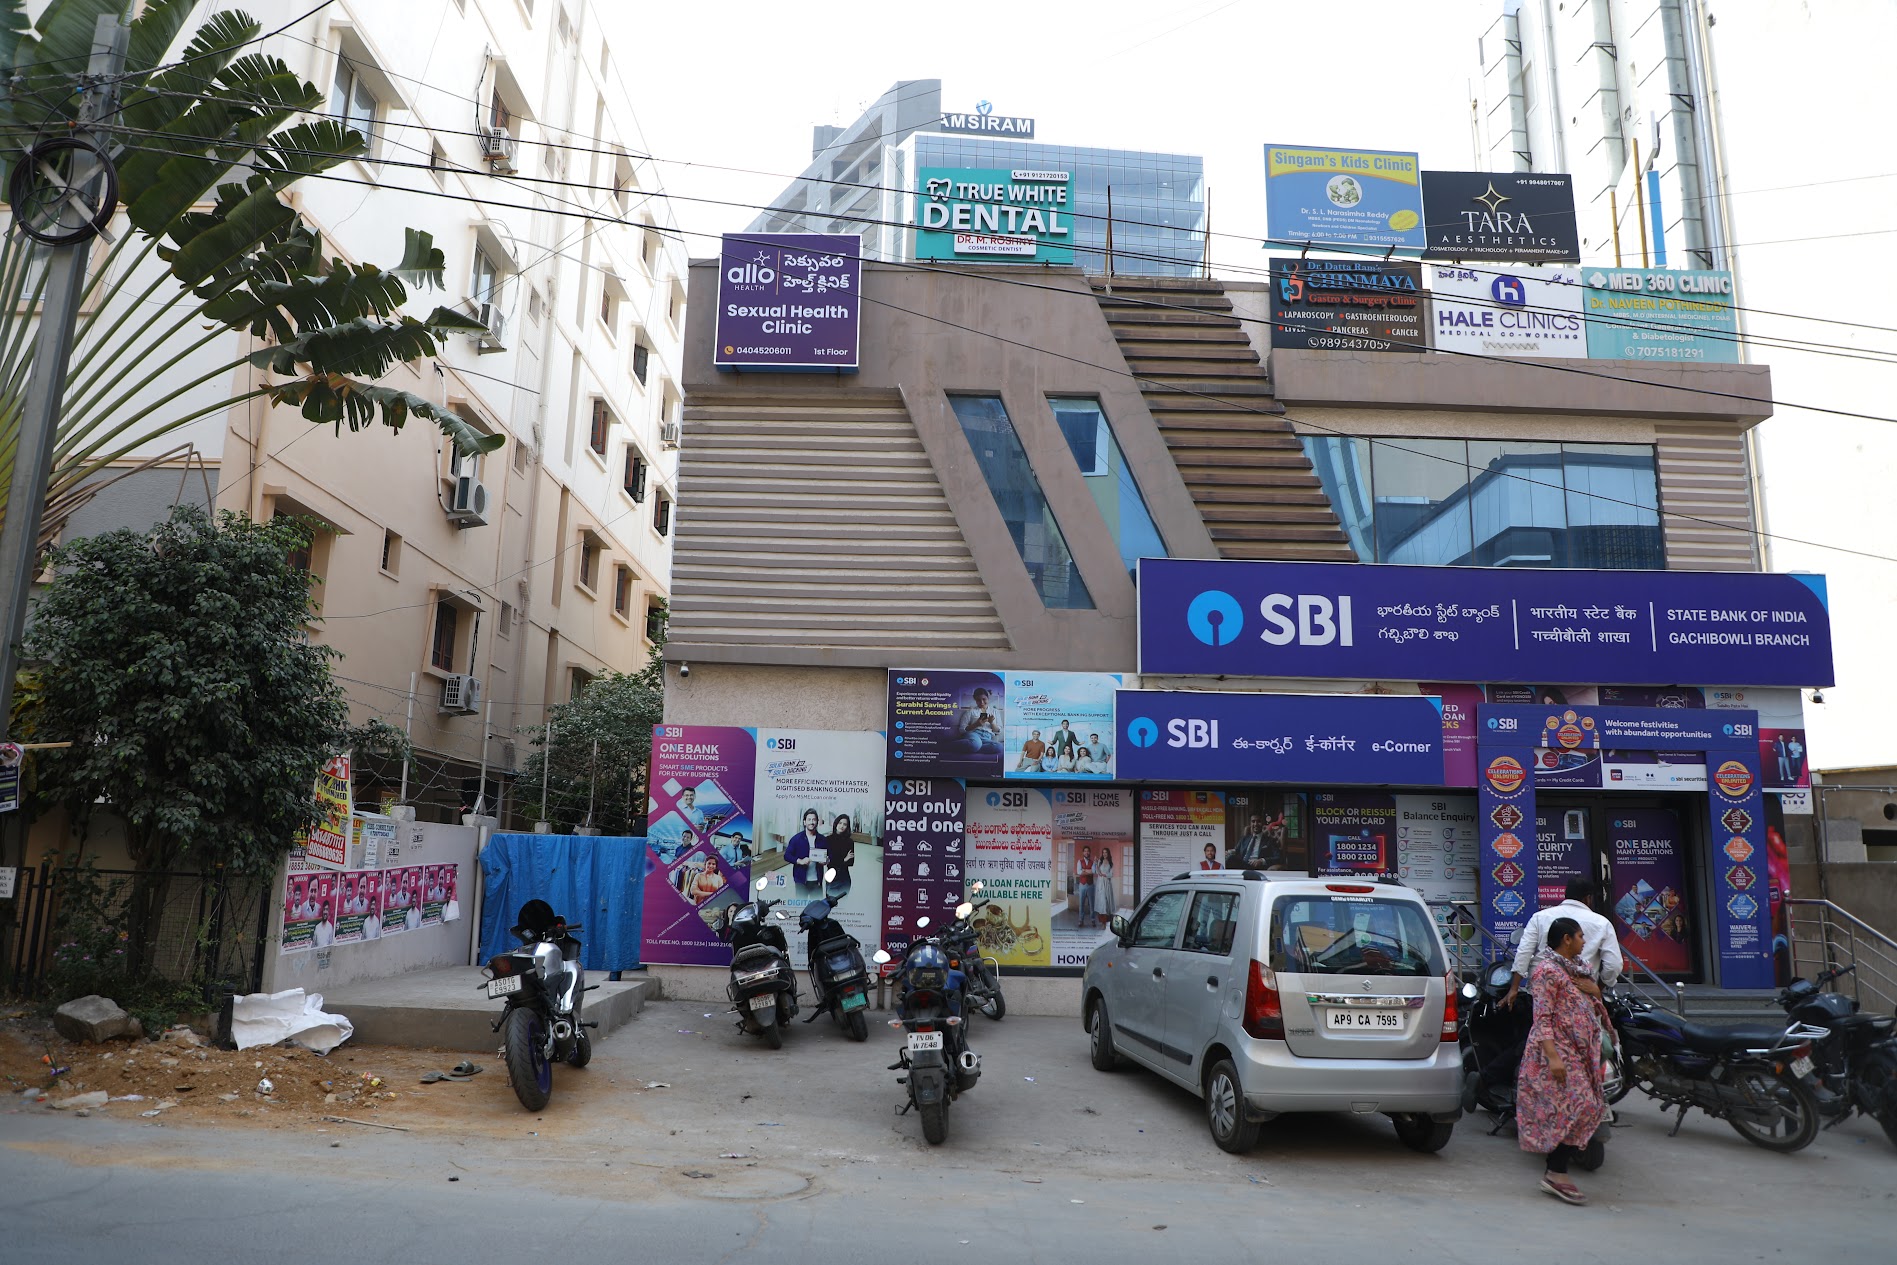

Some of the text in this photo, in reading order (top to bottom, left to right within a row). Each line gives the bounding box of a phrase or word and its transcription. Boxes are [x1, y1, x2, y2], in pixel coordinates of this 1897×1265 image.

[1275, 152, 1412, 171] Singam's Kids Clinic
[957, 183, 1066, 202] TRUE WHITE
[924, 203, 1068, 234] DENTAL
[1328, 209, 1365, 217] Narasimha
[1367, 211, 1389, 220] Reddy
[1461, 211, 1533, 234] TARA
[1288, 230, 1310, 238] Timing:
[957, 235, 987, 245] DR. M.
[1442, 236, 1556, 245] AESTHETICS
[1307, 261, 1350, 271] Dr. Datta
[728, 263, 775, 283] allo
[1308, 273, 1416, 291] CHINMAYA
[1608, 273, 1731, 293] MED 360 CLINIC
[1309, 294, 1417, 306] Gastro & Surgery Clinic
[1591, 298, 1729, 312] Dr. NAVEEN POTHIREDDY
[728, 304, 848, 318] Sexual Health
[1285, 311, 1417, 322] LAPAROSCOPY GASTROENTEROLOGY
[1439, 311, 1579, 330] HALE CLINICS
[762, 320, 812, 334] Clinic
[1332, 326, 1418, 337] PANCREAS CANCER
[1501, 332, 1578, 340] CO-WORKING
[1642, 333, 1694, 343] Diabetologist
[1320, 338, 1390, 349] 9895437059
[737, 346, 848, 356] 04045206011 1st Floor
[1637, 347, 1704, 358] 7075181291
[1377, 603, 1500, 623] భారతీయ స్టేట్ బ్యాంక్
[1530, 604, 1636, 619] भारतीय स्टेट बैंक
[1667, 609, 1807, 622] STATE BANK OF INDIA
[1260, 593, 1352, 646] SBI
[1433, 631, 1458, 641] శాఖ
[1531, 627, 1630, 643] गच्चीबौली शाखा
[1669, 632, 1810, 646] GACHIBOWLI BRANCH
[924, 701, 951, 709] Savings
[1499, 719, 1517, 729] SBI
[1605, 719, 1678, 729] Welcome festivities
[1734, 724, 1752, 735] SBI
[666, 727, 682, 737] SBI
[1167, 718, 1219, 748] SBI
[1624, 729, 1659, 737] abundant
[1661, 730, 1712, 739] opportunities
[660, 743, 719, 754] ONE BANK
[778, 739, 796, 749] SBI
[1305, 735, 1356, 752] ई-कॉर्नर
[1372, 740, 1431, 753] e-Corner
[680, 753, 719, 761] SOLUTIONS
[905, 780, 931, 795] SBI
[1003, 792, 1028, 807] SBI
[1067, 792, 1086, 803] SBI
[1093, 793, 1119, 801] HOME
[1322, 794, 1334, 802] SBI
[886, 799, 961, 817] you only
[1093, 800, 1119, 808] LOANS
[1316, 807, 1396, 817] BLOCK OR REISSUE
[1403, 811, 1475, 822] Balance Enquiry
[886, 817, 963, 832] need one
[1316, 816, 1385, 825] YOUR ATM CARD
[1623, 820, 1636, 828] SBI
[1358, 843, 1376, 851] 1234
[1616, 839, 1672, 849] ONE BANK
[1358, 853, 1377, 861] 2100
[990, 879, 1011, 888] LOAN
[1014, 879, 1051, 889] FACILITY
[1021, 890, 1042, 900] HERE
[887, 941, 907, 950] yono
[1334, 1014, 1397, 1026] AP9 CA 7595
